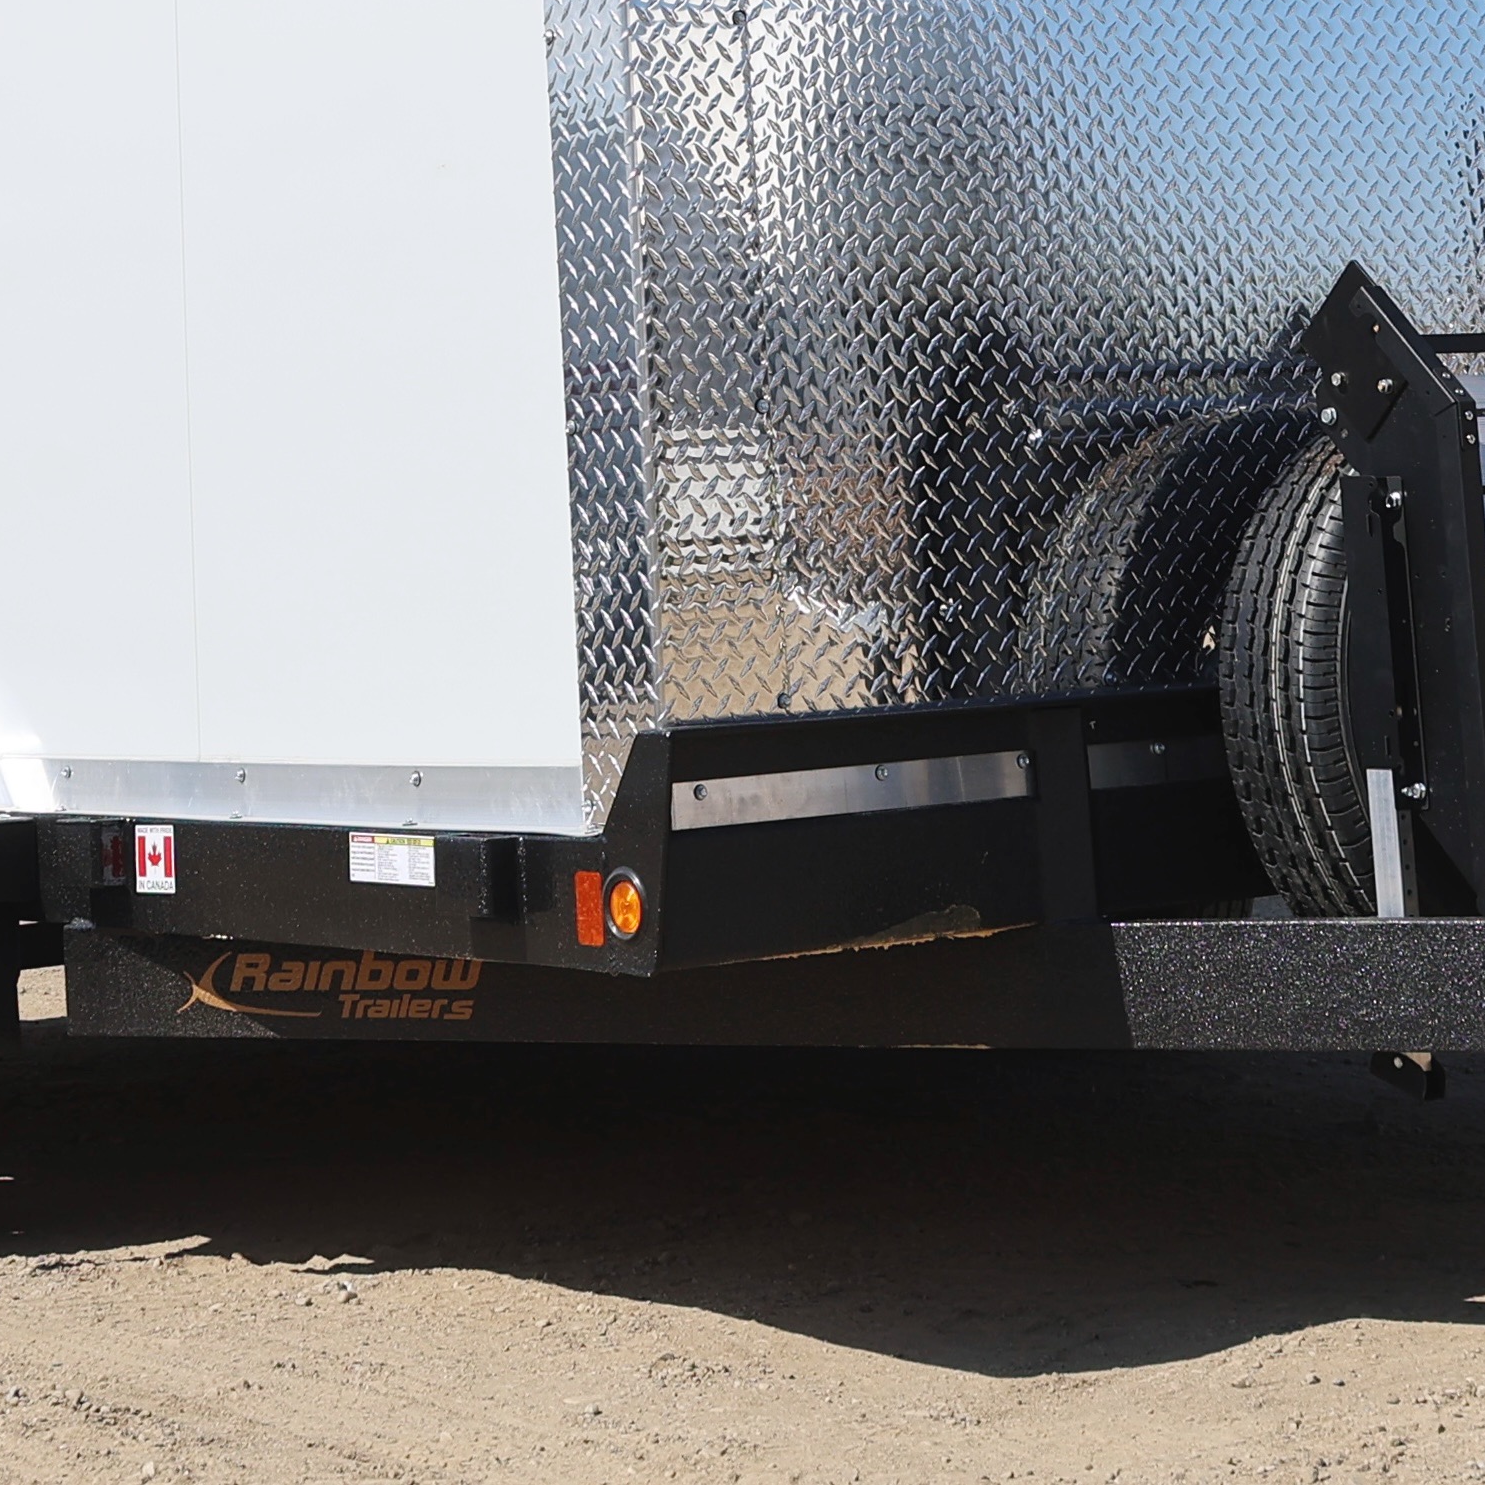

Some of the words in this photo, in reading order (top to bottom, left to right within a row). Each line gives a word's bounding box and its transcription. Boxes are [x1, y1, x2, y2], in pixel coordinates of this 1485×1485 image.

[138, 880, 146, 890] IN
[147, 880, 173, 890] CANADA
[229, 950, 484, 991] Rainbow
[338, 993, 474, 1020] Trailers
